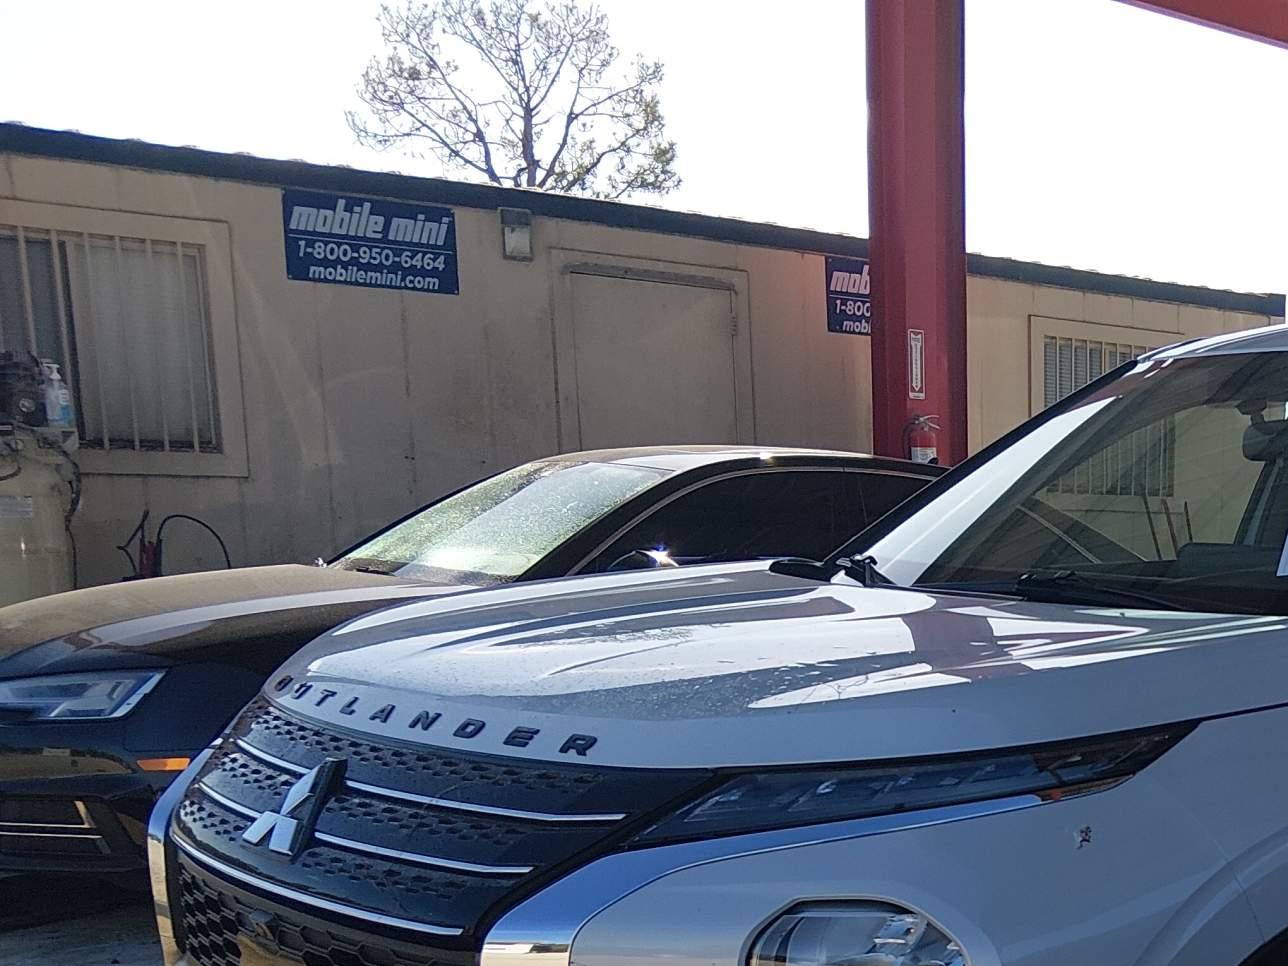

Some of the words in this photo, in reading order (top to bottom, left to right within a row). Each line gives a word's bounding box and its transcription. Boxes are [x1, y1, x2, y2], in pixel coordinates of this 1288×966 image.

[289, 199, 385, 239] mobile
[388, 214, 448, 246] mini
[298, 240, 446, 271] 1-800-950-6464
[308, 265, 440, 290] mobilemini.com
[274, 675, 598, 757] OUTLANDER
